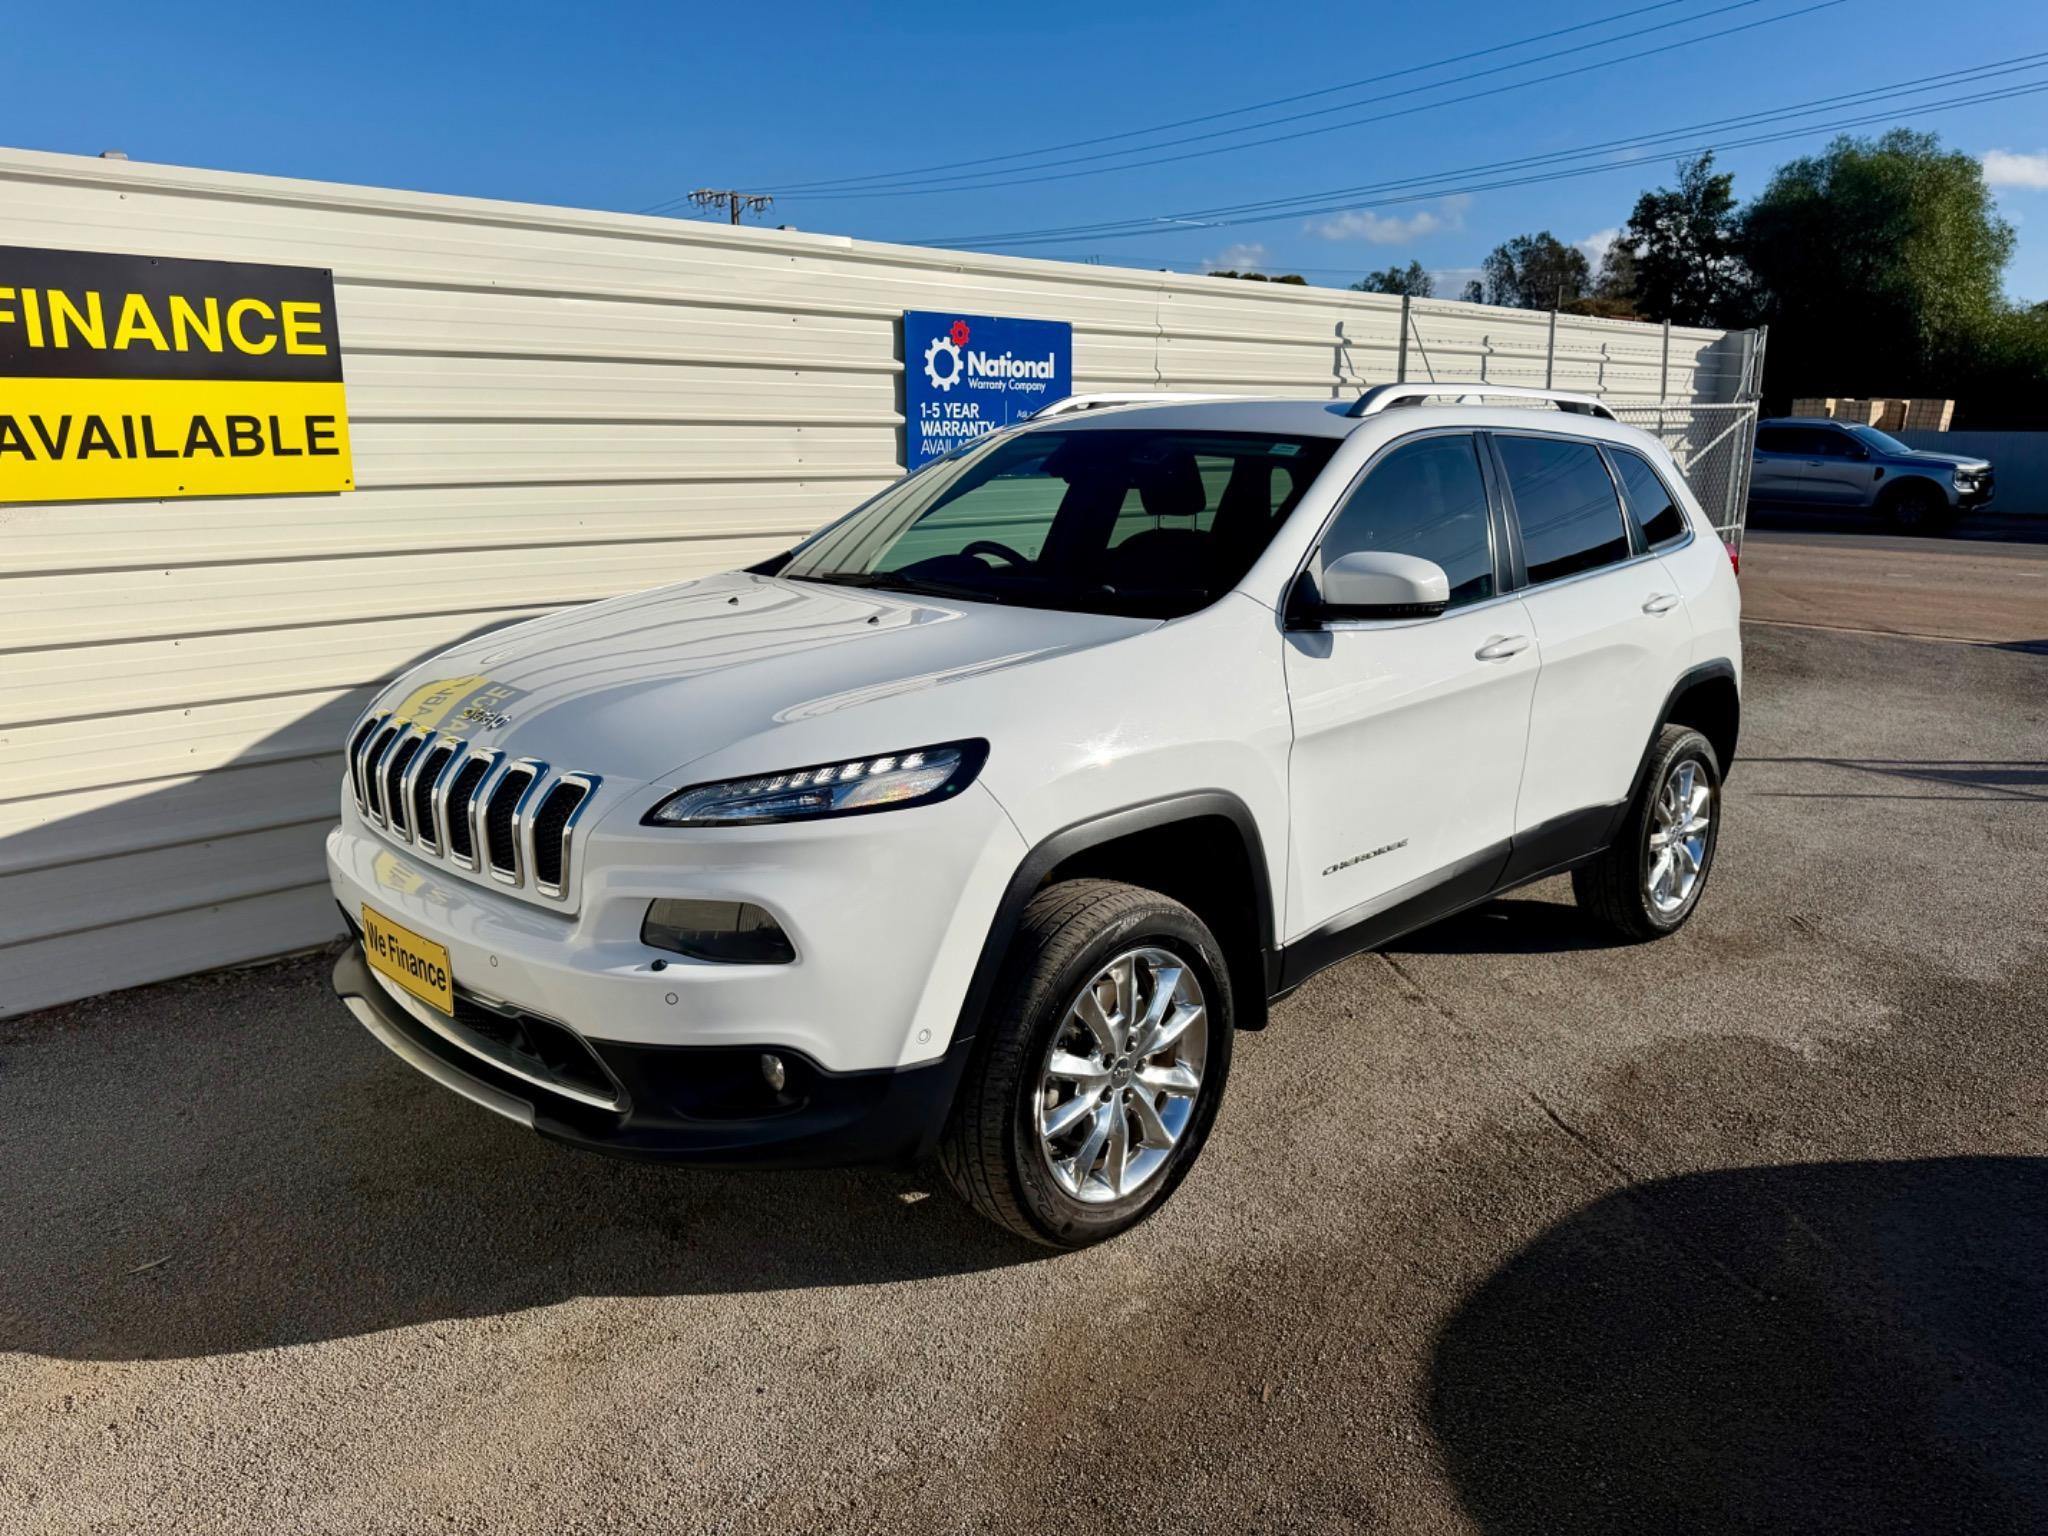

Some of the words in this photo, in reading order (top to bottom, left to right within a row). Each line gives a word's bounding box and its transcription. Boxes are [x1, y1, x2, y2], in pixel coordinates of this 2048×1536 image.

[967, 351, 1055, 379] National
[968, 378, 1007, 393] Warranty
[1008, 379, 1047, 394] Company
[920, 402, 941, 419] 1-5
[944, 402, 980, 419] YEAR
[0, 414, 340, 461] AVAILABLE
[920, 420, 996, 437] WARRANTY
[365, 919, 387, 957] We
[387, 933, 448, 992] Finance
